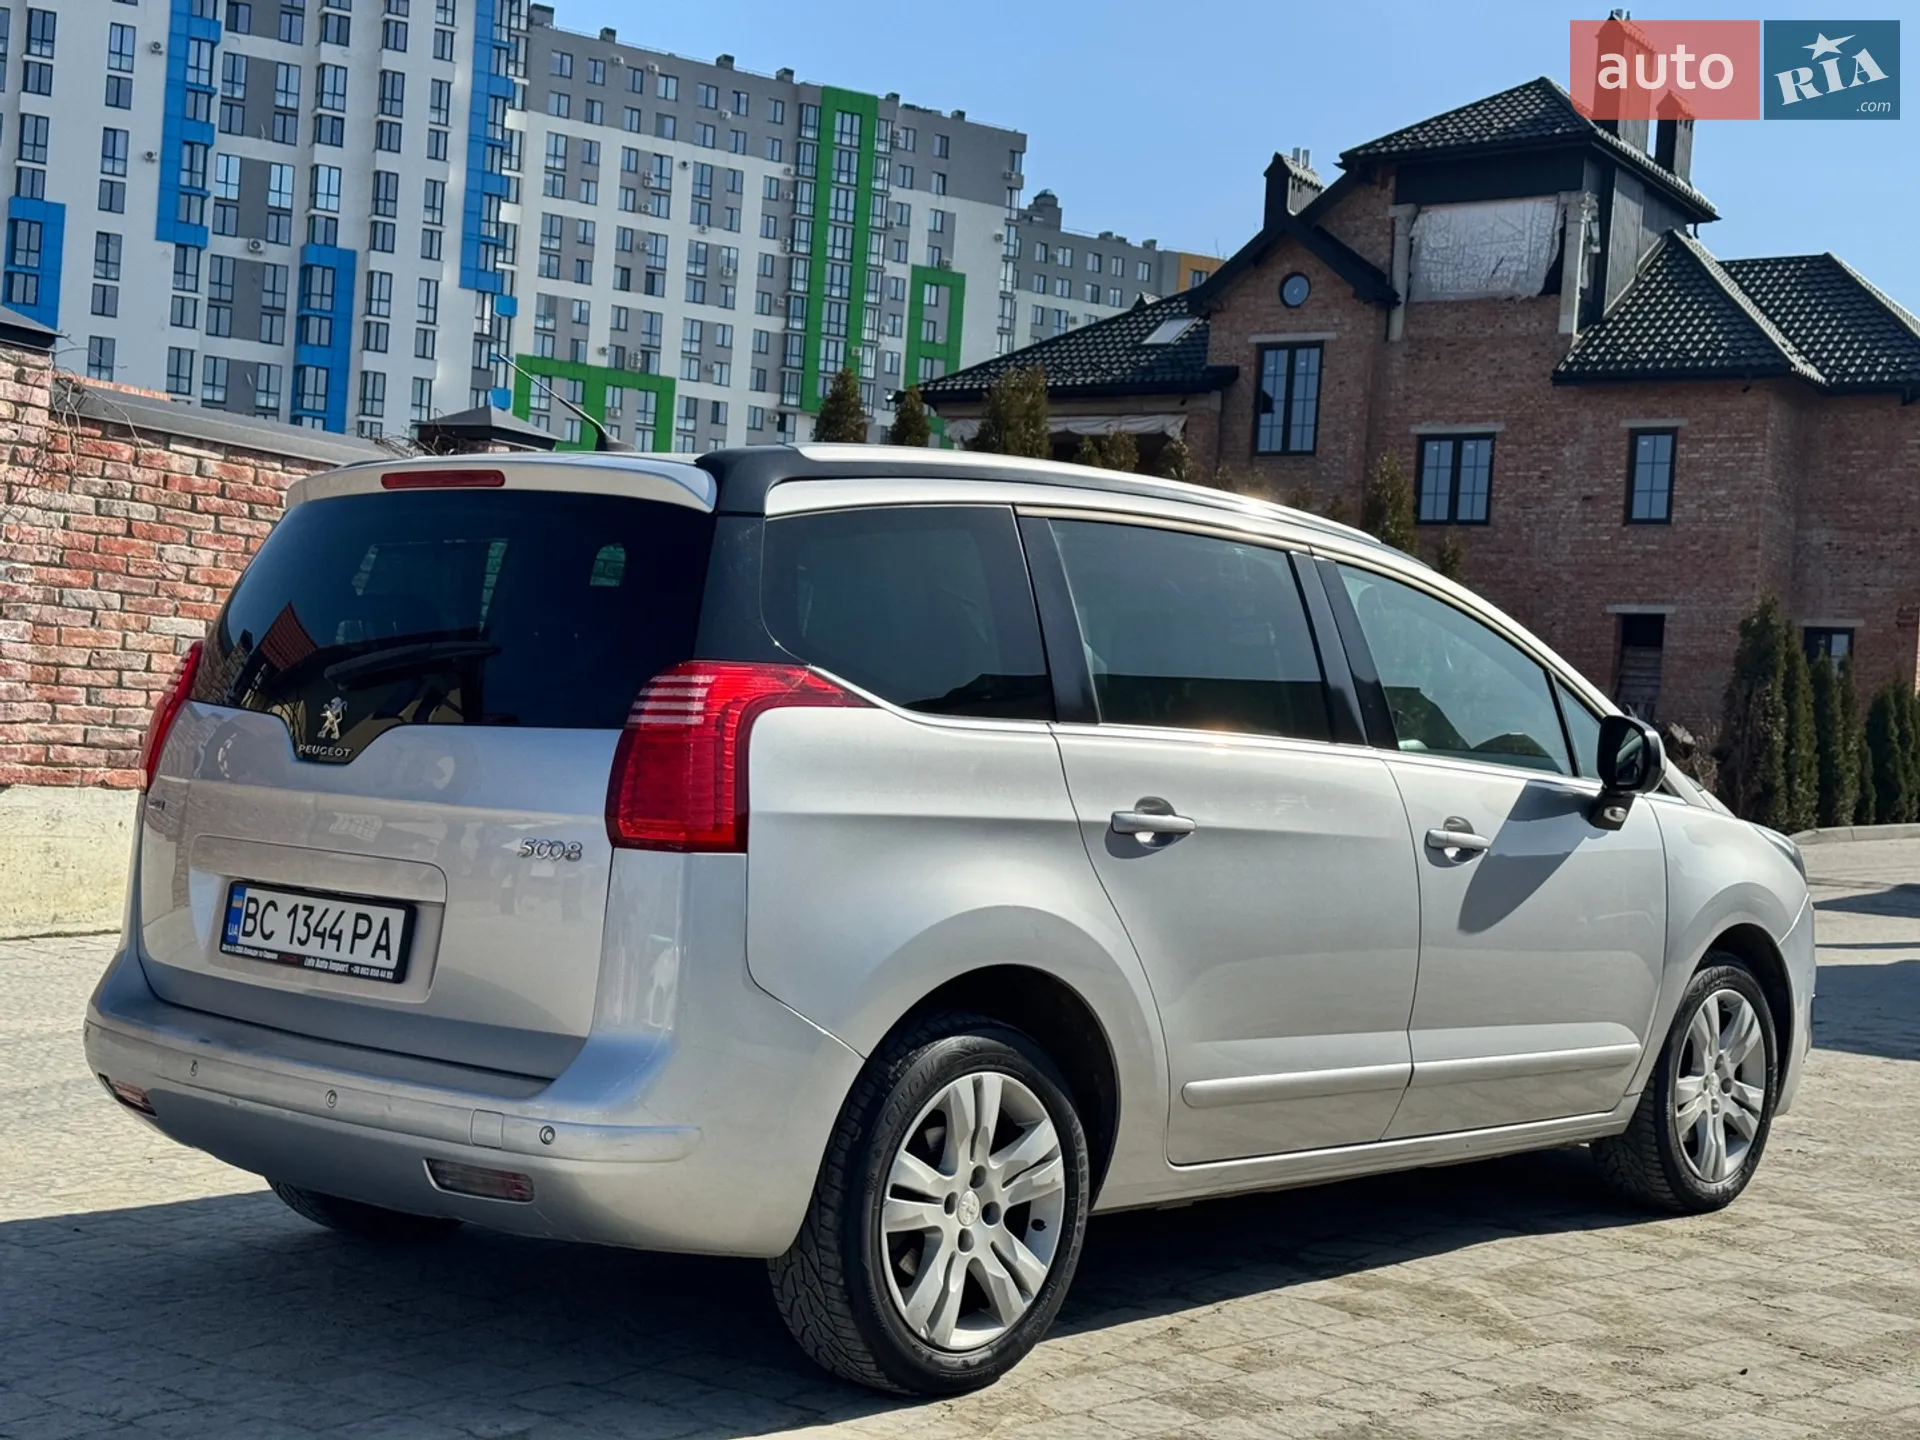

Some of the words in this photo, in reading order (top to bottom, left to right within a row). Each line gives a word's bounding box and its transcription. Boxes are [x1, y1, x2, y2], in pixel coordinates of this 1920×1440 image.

[298, 744, 352, 757] PEUGEOT
[517, 837, 583, 862] 5008
[228, 922, 239, 936] UA
